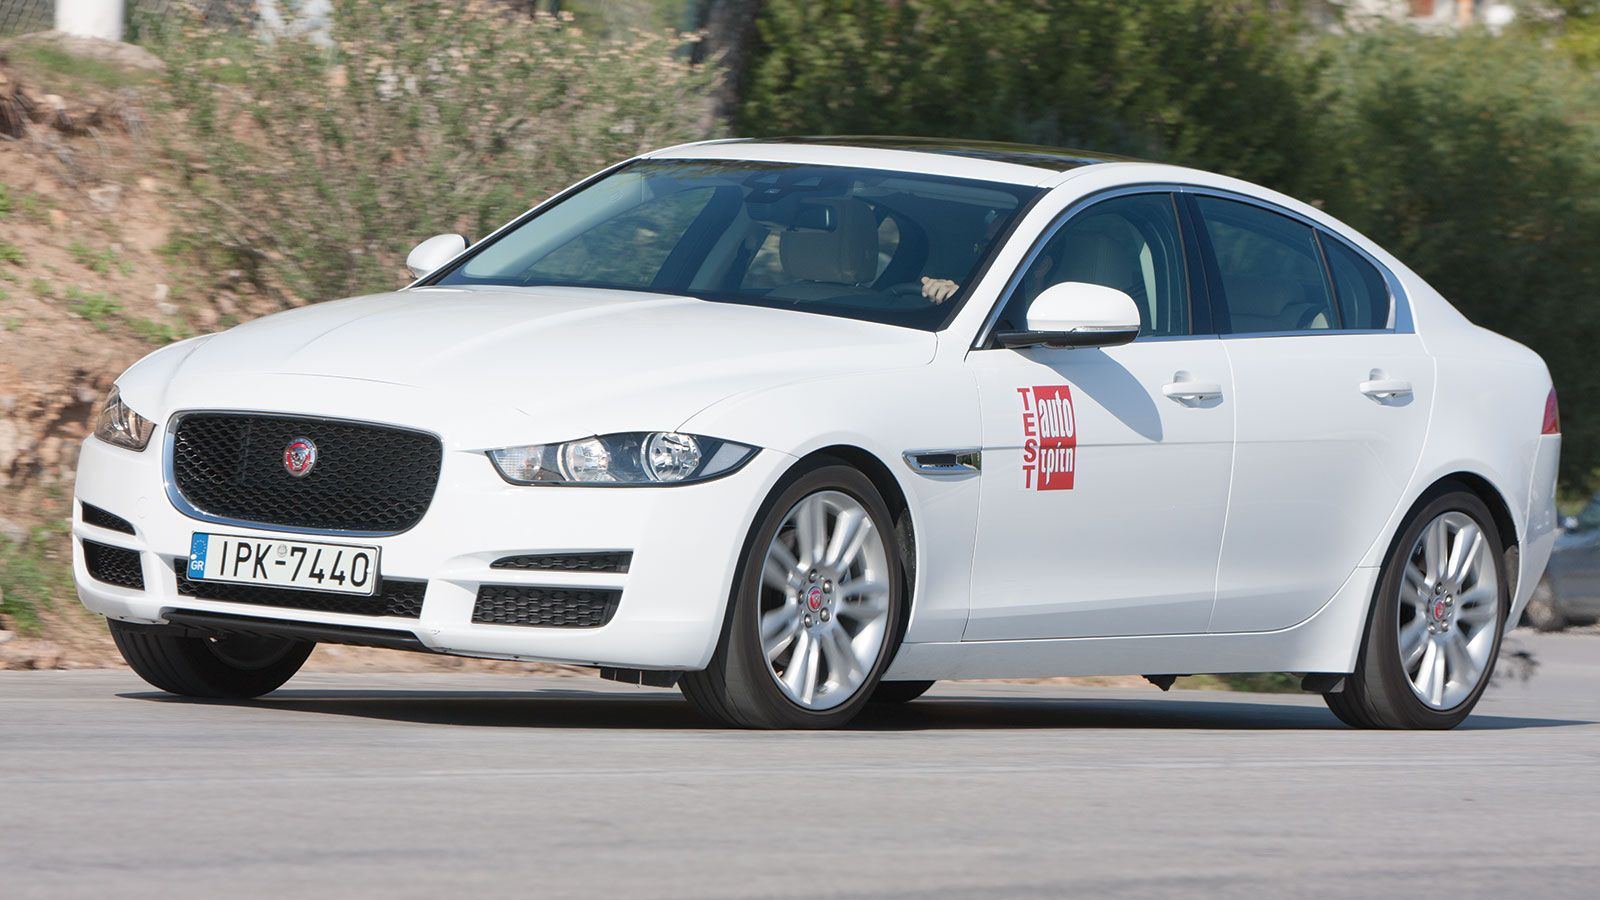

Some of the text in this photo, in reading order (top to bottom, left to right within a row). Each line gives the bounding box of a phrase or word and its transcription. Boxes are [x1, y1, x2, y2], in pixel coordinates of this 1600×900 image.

[1038, 390, 1074, 438] auto
[1017, 387, 1038, 489] TEST
[191, 560, 204, 571] GR
[220, 540, 369, 587] IPK-7440
